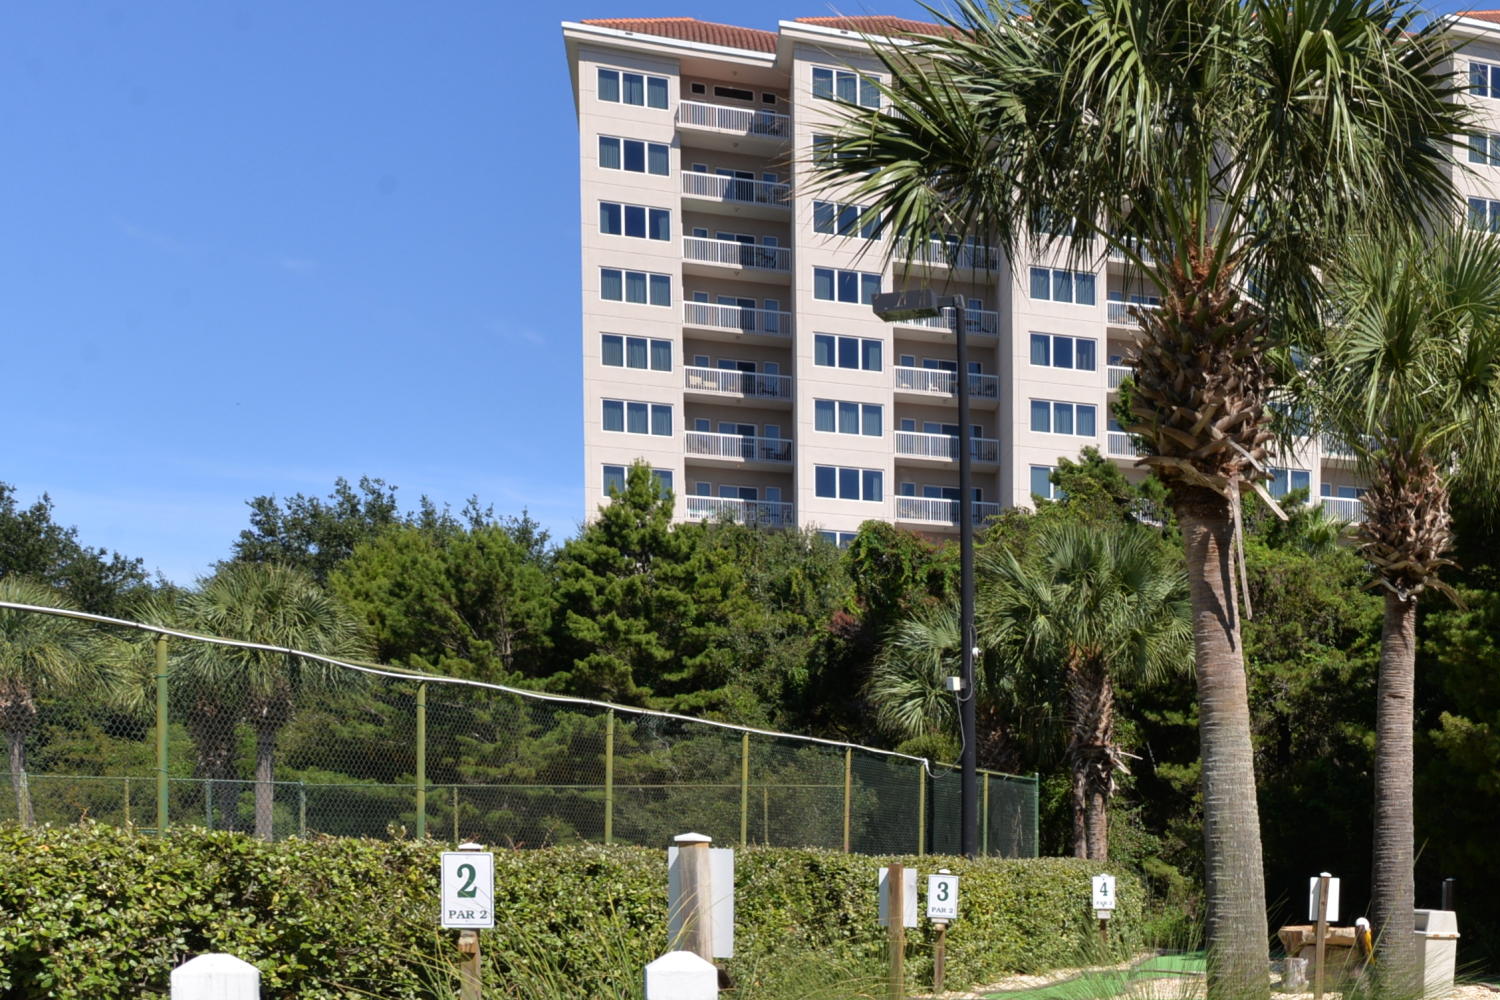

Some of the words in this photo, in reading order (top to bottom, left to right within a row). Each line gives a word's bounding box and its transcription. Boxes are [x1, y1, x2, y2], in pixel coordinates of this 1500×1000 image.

[456, 863, 477, 898] 2
[1099, 882, 1109, 896] 4
[937, 881, 949, 901] 3
[448, 909, 475, 920] PAR
[479, 909, 488, 919] 2
